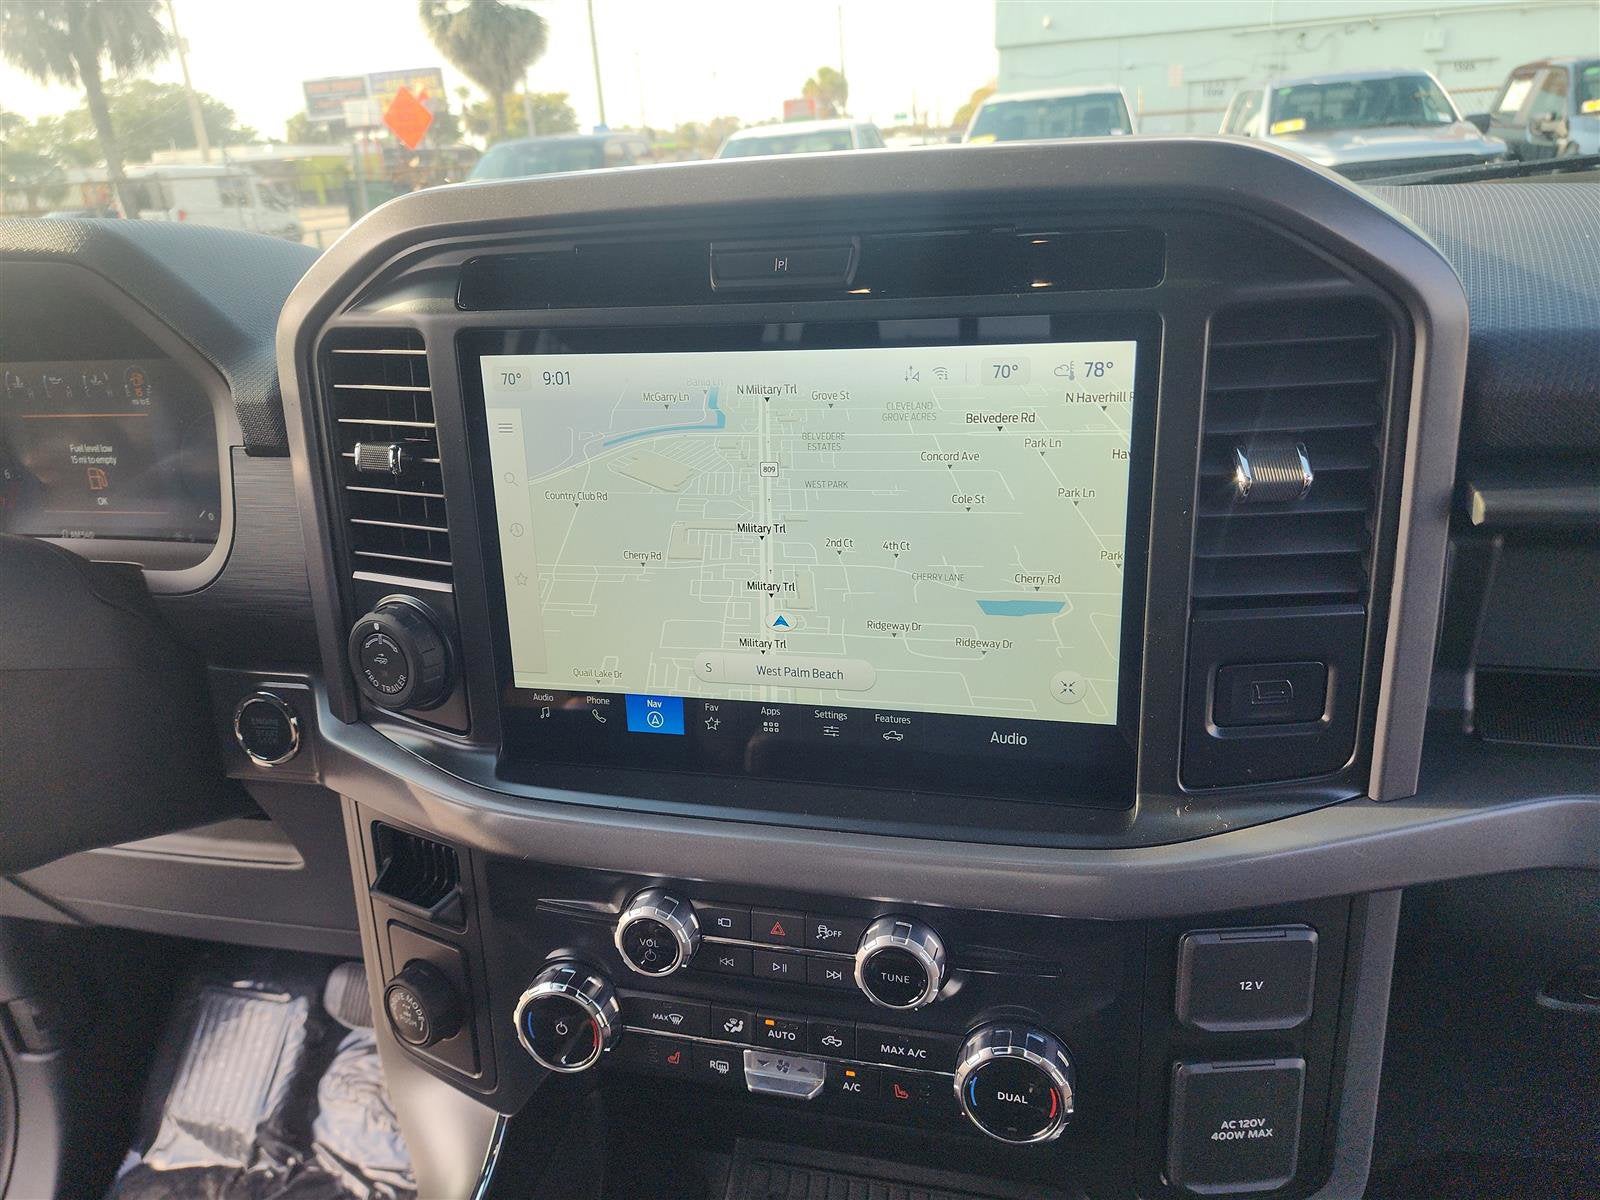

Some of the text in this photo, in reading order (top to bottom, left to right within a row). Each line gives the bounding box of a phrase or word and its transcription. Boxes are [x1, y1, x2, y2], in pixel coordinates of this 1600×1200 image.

[992, 364, 1019, 379] 70°
[1084, 361, 1114, 378] 78°
[501, 372, 522, 386] 70°
[542, 371, 571, 386] 9:01
[736, 384, 797, 396] N Military Trl
[643, 392, 690, 402] McGarry Ln
[811, 391, 850, 401] Grove St
[1065, 393, 1074, 403] N
[1076, 391, 1127, 403] Haverhill
[886, 401, 933, 411] CLEVELAND
[882, 412, 937, 422] GROVE ACRES
[966, 412, 1036, 424] Belvedere Rd
[801, 432, 846, 441] BELVEDERE
[807, 442, 841, 451] ESTATES
[1024, 438, 1062, 448] Park Ln
[920, 452, 980, 462] Concord Ave
[762, 465, 776, 474] 809
[805, 480, 849, 489] WEST PARK
[544, 491, 608, 502] Country Club Rd
[1057, 488, 1095, 498] Park Ln
[951, 495, 986, 504] Cole St
[737, 524, 786, 535] Military Trl
[825, 538, 854, 548] 2nd Ct
[882, 541, 911, 551] 4th Ct
[623, 550, 662, 561] Cherry Rd
[1100, 551, 1123, 560] Park
[911, 572, 965, 582] CHERRY LANE
[1014, 573, 1061, 585] Cherry Rd
[747, 581, 796, 593] Military Trl
[866, 620, 922, 632] Ridgeway Dr
[739, 638, 787, 650] Military Trl
[955, 637, 1013, 649] Ridgeway Dr
[572, 668, 623, 679] Quail Lake Dr
[705, 663, 844, 680] S West Palm Beach
[365, 669, 406, 693] PRO TRAILER
[533, 692, 554, 702] Audio
[586, 695, 610, 705] Phone
[647, 700, 662, 708] Nav
[704, 703, 719, 711] Fav
[760, 706, 781, 717] Apps
[814, 709, 848, 722] Settings
[874, 713, 911, 725] Features
[990, 731, 1028, 746] Audio
[826, 930, 842, 938] OFF
[639, 938, 660, 948] VOL
[881, 972, 910, 984] TUNE
[1239, 980, 1264, 991] 12 V
[652, 1012, 668, 1021] MAX
[767, 1029, 796, 1041] AUTO
[880, 1044, 927, 1059] MAX A/C
[842, 1082, 861, 1093] A/C
[997, 1091, 1028, 1104] DUAL
[1220, 1118, 1266, 1130] AC 120V
[1211, 1128, 1273, 1141] 400W MAX
